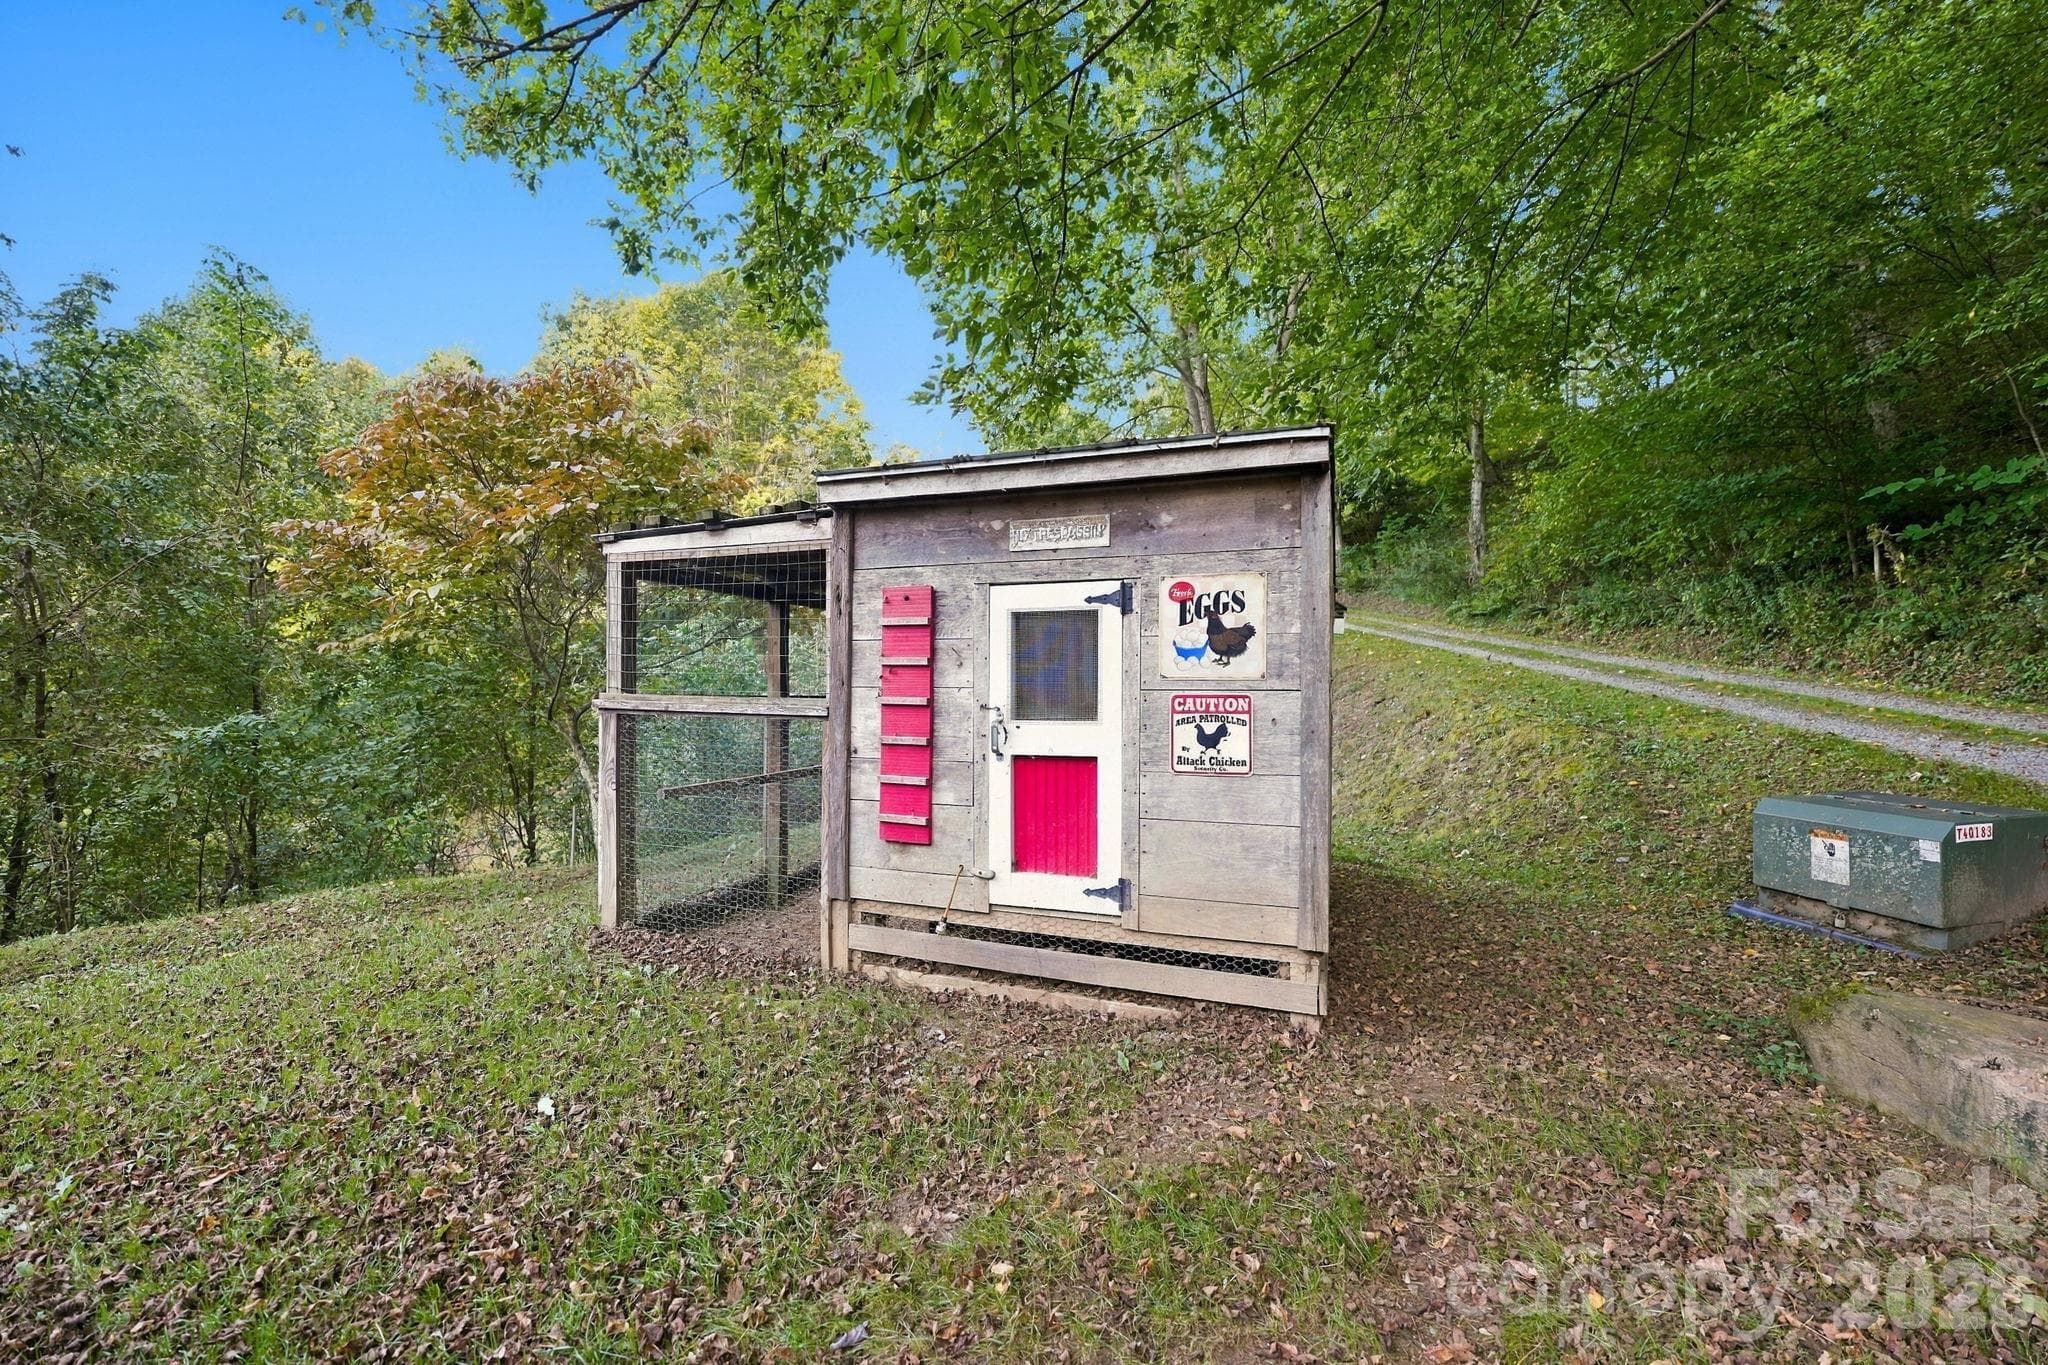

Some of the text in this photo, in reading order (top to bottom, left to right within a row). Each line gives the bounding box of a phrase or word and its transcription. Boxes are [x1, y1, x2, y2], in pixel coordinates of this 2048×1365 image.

[1178, 590, 1246, 627] EGGS
[1173, 697, 1250, 712] CAUTION
[1175, 714, 1247, 727] AREA PATROLLED
[1176, 755, 1247, 767] Attack Chicken
[1956, 825, 1992, 841] T40183
